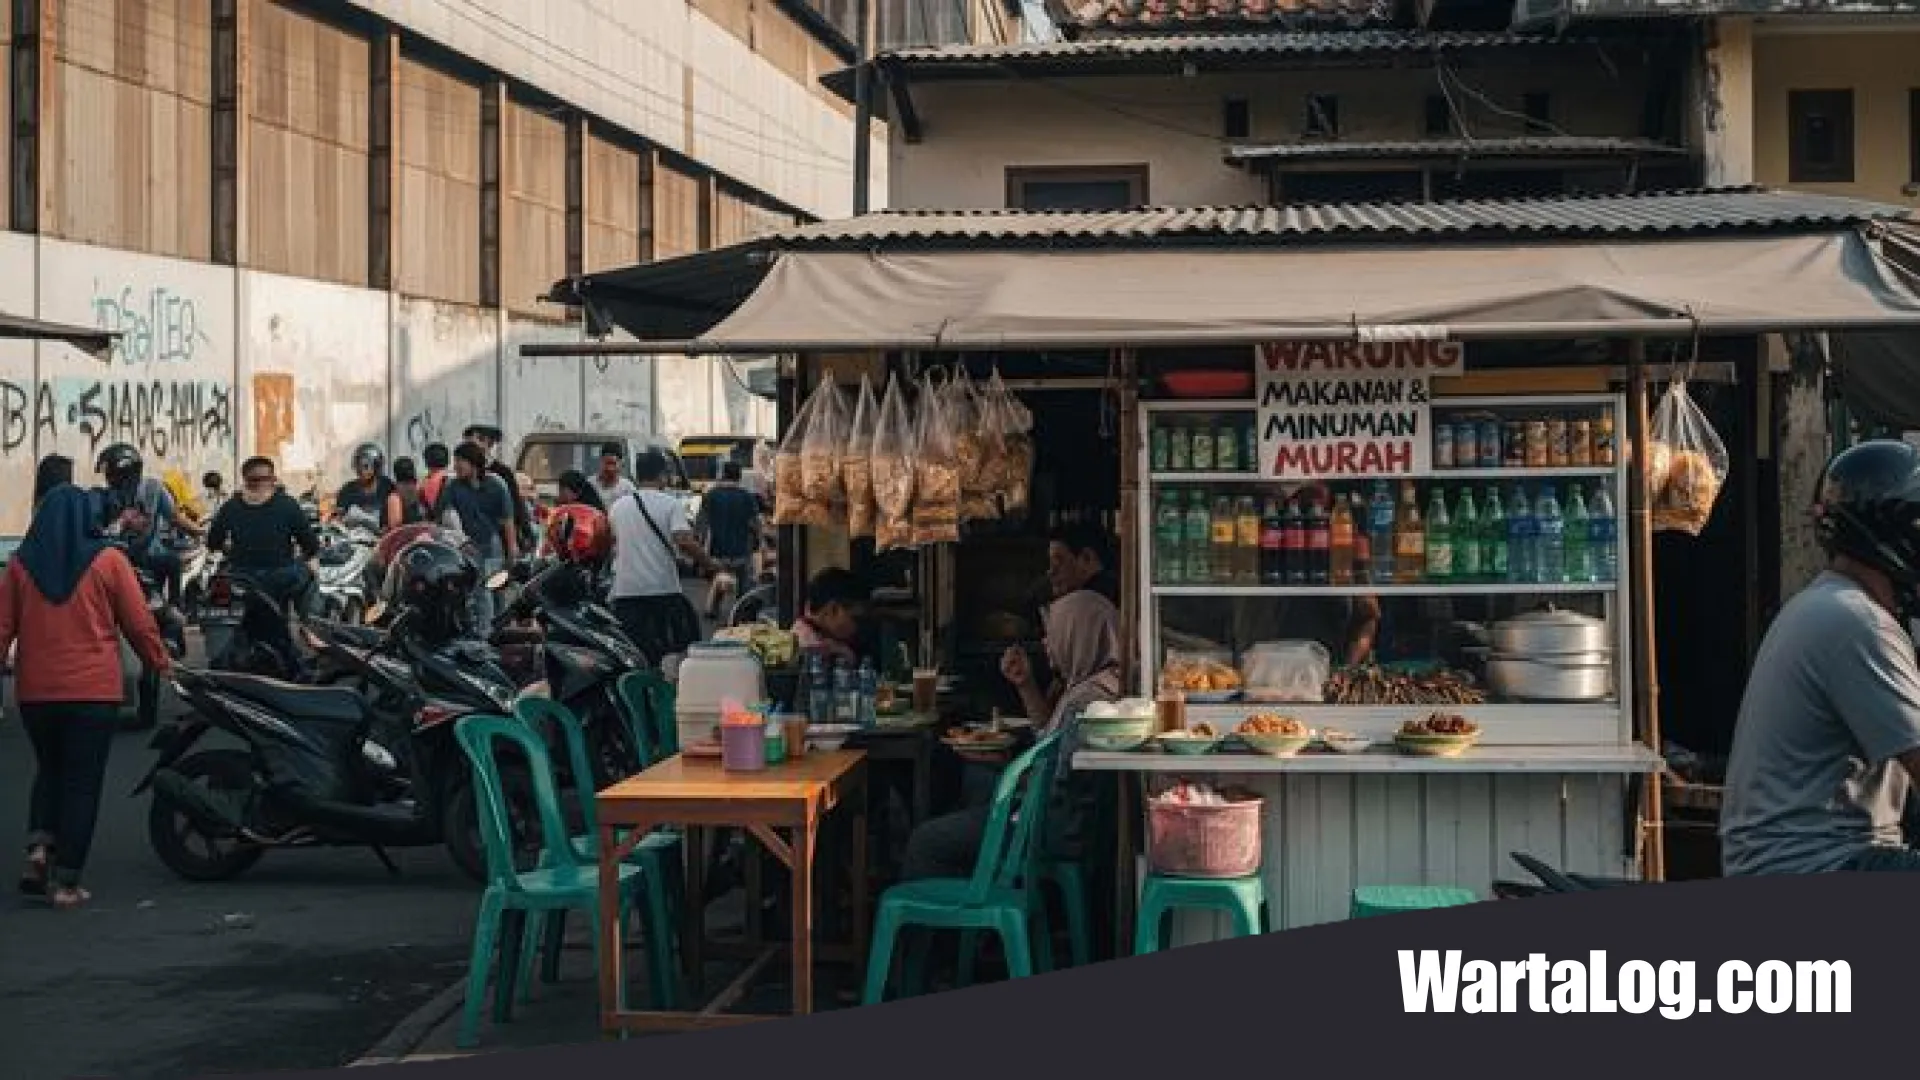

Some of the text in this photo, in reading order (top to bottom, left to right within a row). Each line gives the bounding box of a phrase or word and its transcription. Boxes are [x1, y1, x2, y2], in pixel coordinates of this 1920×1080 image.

[1261, 340, 1459, 370] WARUNG
[1262, 378, 1428, 406] MAKANAN &
[1265, 410, 1416, 439] MINUMAN
[1273, 441, 1413, 475] MURAH
